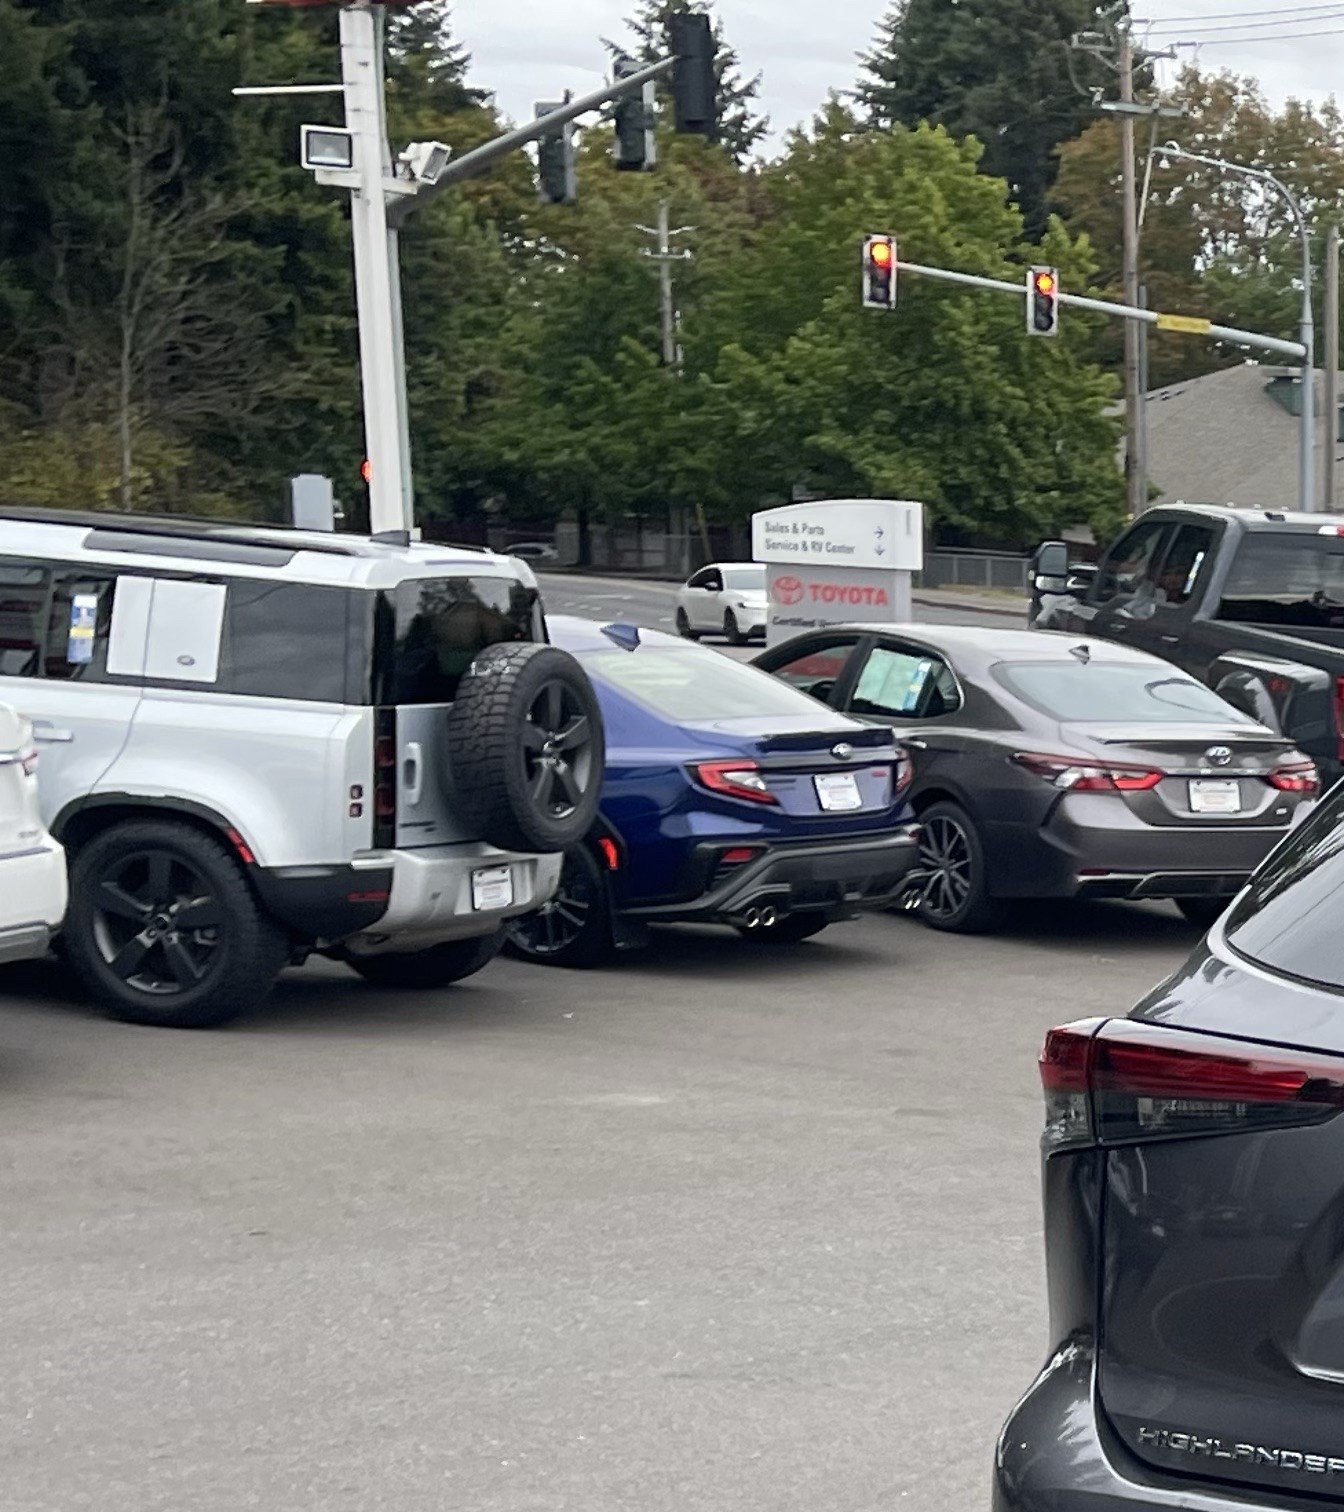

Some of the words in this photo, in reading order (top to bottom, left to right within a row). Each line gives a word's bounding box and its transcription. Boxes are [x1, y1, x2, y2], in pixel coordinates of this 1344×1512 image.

[765, 521, 790, 534] Sales
[801, 522, 825, 536] Parts
[765, 538, 799, 552] Service
[808, 583, 889, 605] TOYOTA
